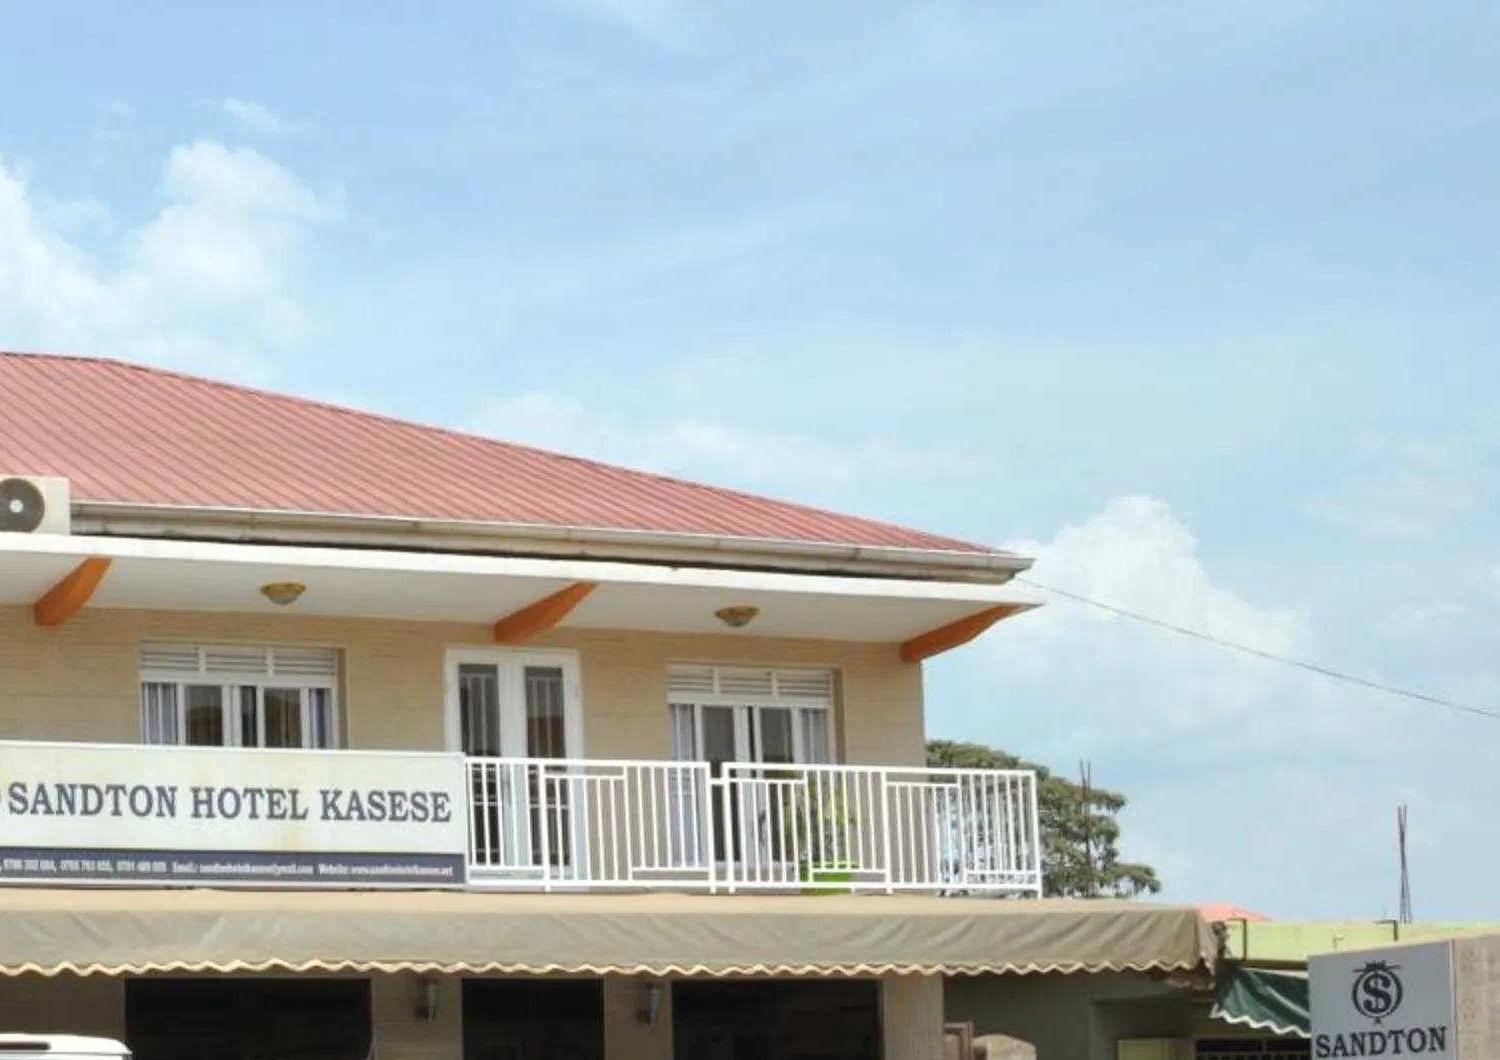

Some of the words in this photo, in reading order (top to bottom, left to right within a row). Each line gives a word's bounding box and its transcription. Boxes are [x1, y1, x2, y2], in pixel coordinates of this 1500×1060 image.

[8, 782, 177, 817] SANDTON
[190, 786, 309, 820] HOTEL
[319, 790, 452, 822] KASESE
[1315, 1026, 1447, 1059] SANDTON
